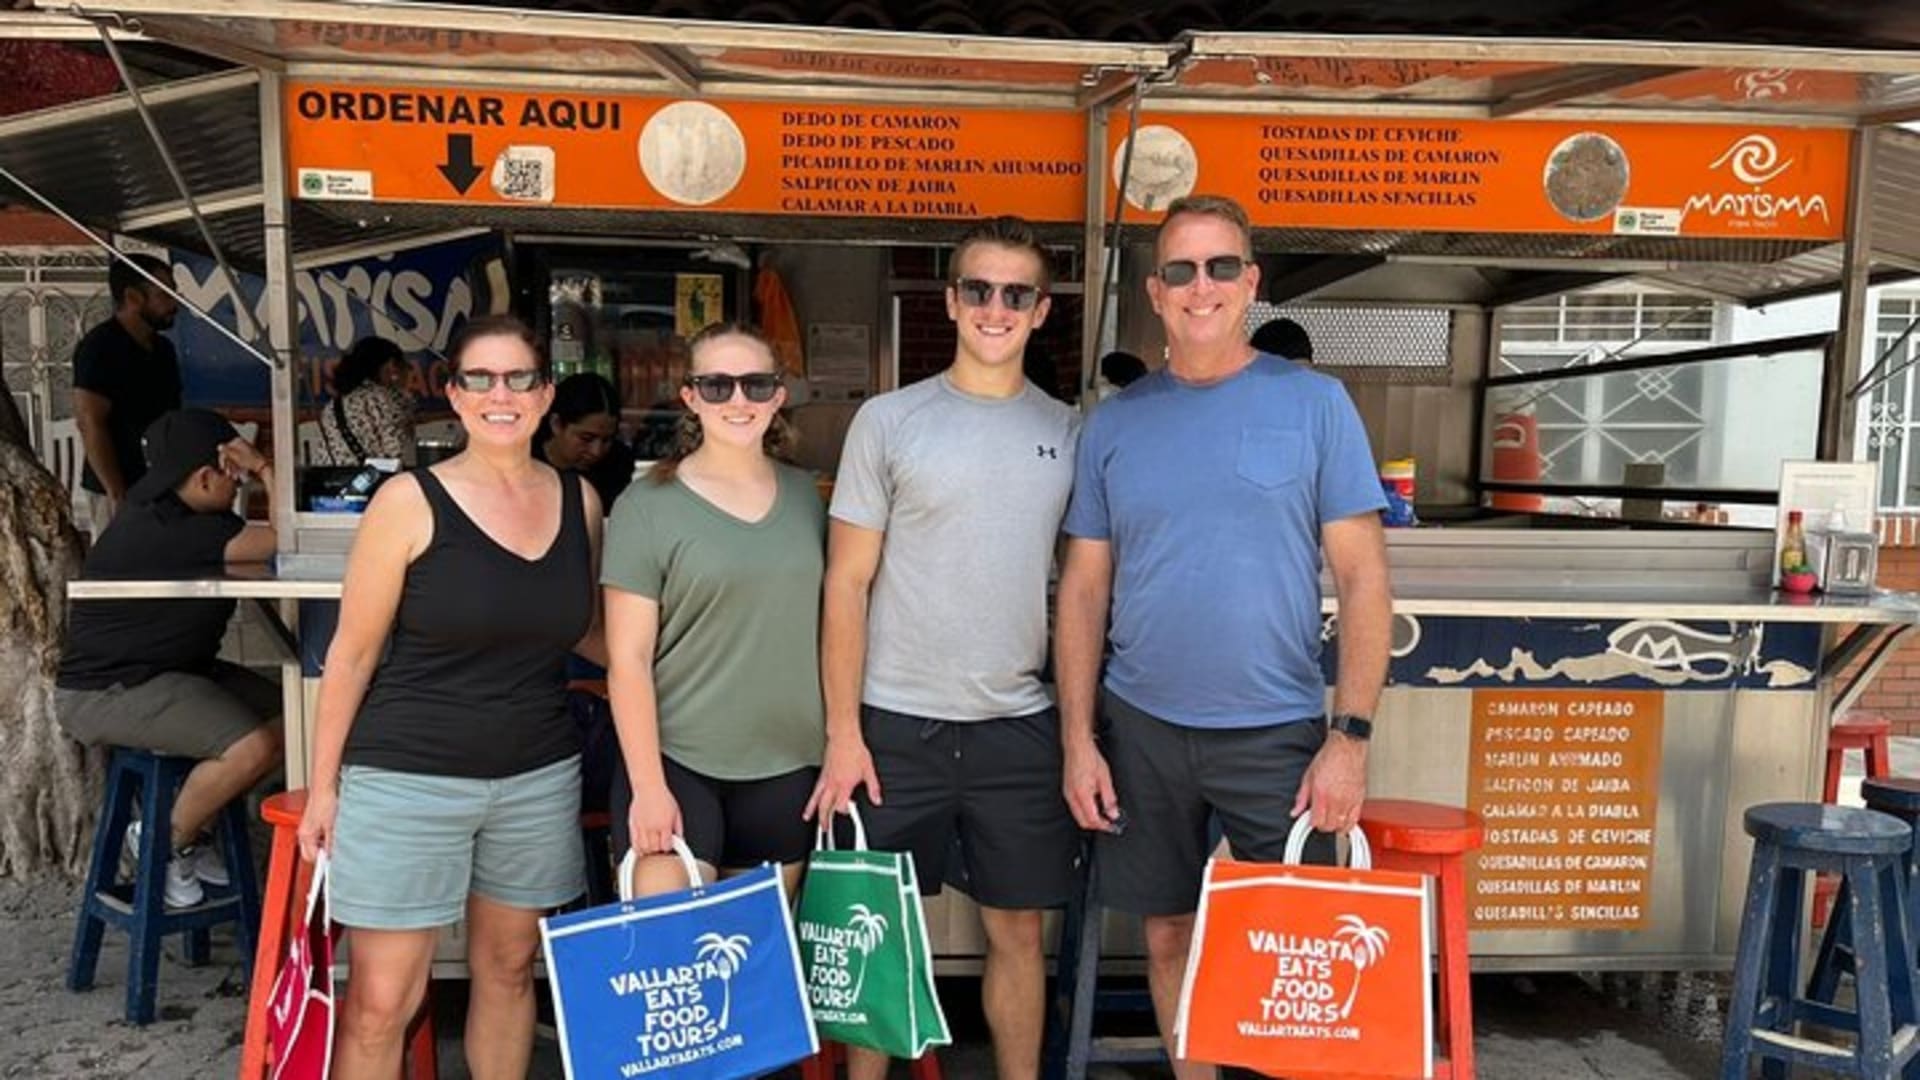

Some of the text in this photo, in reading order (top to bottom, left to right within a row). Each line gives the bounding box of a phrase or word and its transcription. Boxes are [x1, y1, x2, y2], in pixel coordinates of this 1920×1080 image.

[298, 91, 621, 130] ORDENAR AQUI
[782, 111, 961, 129] DEDO DE CAMARON
[782, 133, 955, 151] DEDO DE PESCADO
[1260, 125, 1463, 142] TOSTADAS DE CEVICHE
[1260, 146, 1499, 163] QUESADILLAS DE CAMARON
[782, 155, 1083, 176] PICADILLO DE MARLIN AHUMADO
[781, 177, 956, 194] SALPICON DE JAIBA
[1259, 168, 1480, 185] QUESADILLAS DE MARLIN
[782, 197, 978, 215] CALAMAR A LA DIABLA
[1258, 188, 1476, 206] QUESADILLAS SENCILLAS
[1488, 702, 1633, 717] CAMARON CAPEADO
[1485, 726, 1631, 742] PESCADO CAPEADO
[1561, 778, 1579, 793] DE
[1586, 778, 1630, 793] JAIBA
[1551, 804, 1562, 818] A
[1567, 804, 1585, 818] LA
[1589, 804, 1640, 819] DIABLA
[1567, 829, 1585, 844] DE
[1591, 829, 1652, 845] CEVICHE
[1479, 855, 1647, 870] QUESADILLAS DE CAMARON
[1476, 879, 1641, 894] QUESADILLAS DE MARLIN
[1474, 906, 1640, 921] QUESADILLS SENCILLAS
[800, 922, 863, 948] VALLARTA
[1248, 930, 1353, 961] VALLARTA
[815, 944, 848, 966] EATS
[810, 965, 851, 987] FOOD
[1278, 956, 1331, 979] EATS
[610, 960, 718, 995] VALLARTA
[645, 983, 702, 1010] EATS
[807, 984, 853, 1008] TOURS
[1271, 978, 1334, 999] FOOD
[645, 1005, 709, 1032] FOOD
[1260, 998, 1338, 1023] TOURS
[636, 1019, 718, 1057] TOURS
[1237, 1021, 1360, 1040] VALLARTAEATS.COM
[620, 1034, 743, 1078] VALLARTAEATS.COM
